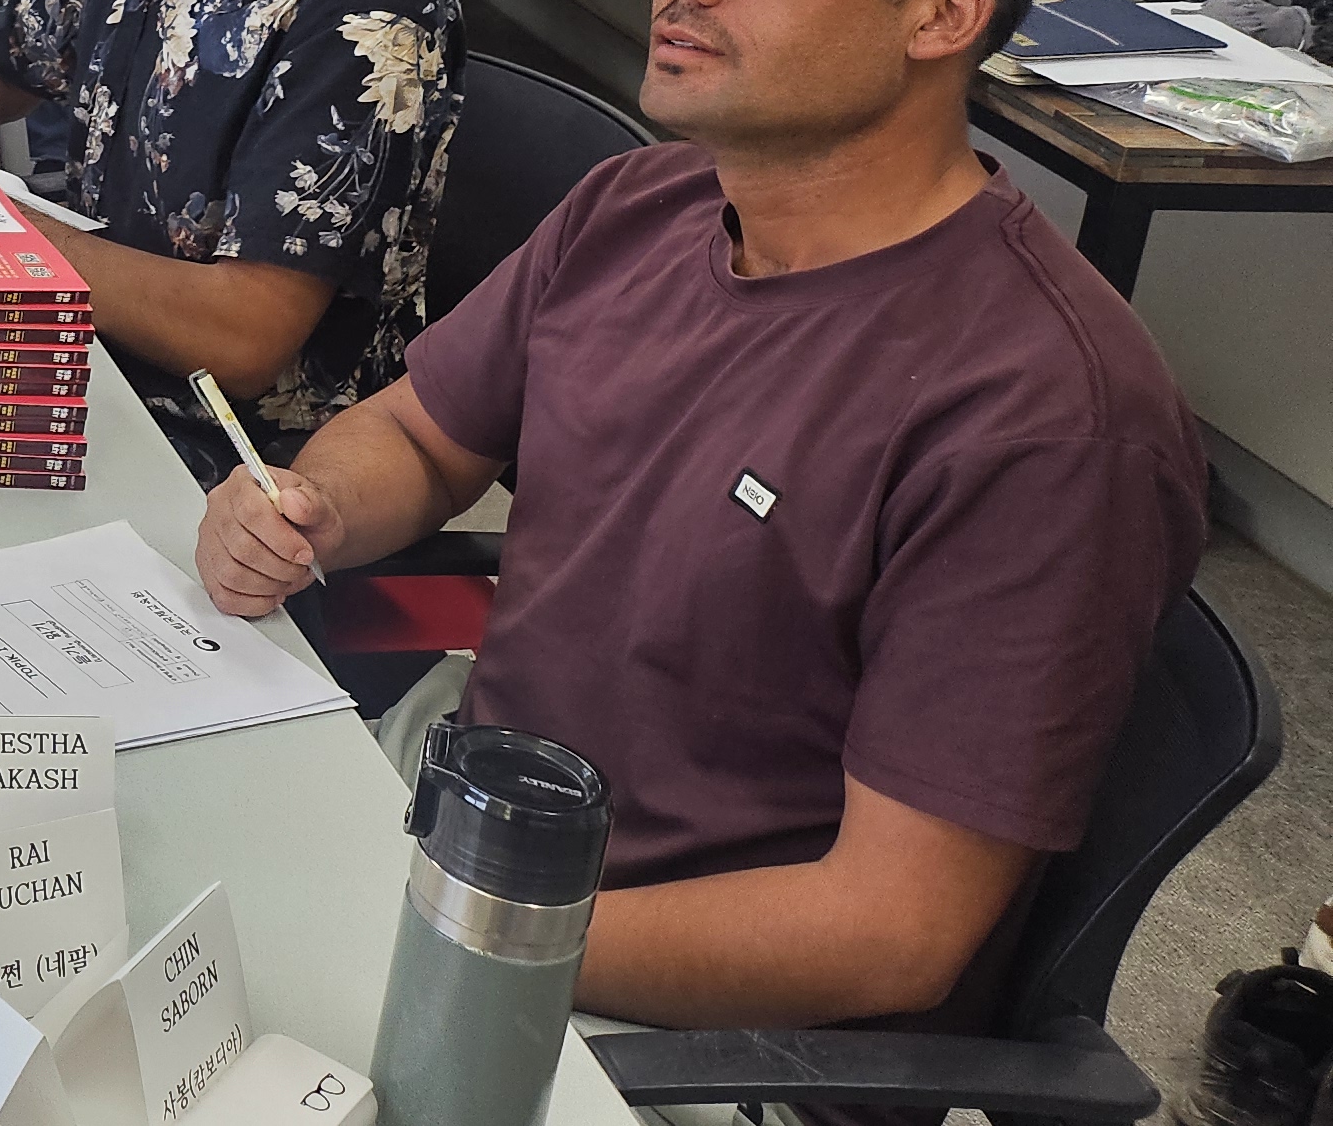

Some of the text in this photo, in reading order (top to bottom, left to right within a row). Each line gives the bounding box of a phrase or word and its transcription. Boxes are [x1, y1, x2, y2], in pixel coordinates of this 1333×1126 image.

[8, 653, 39, 679] TOPIK
[8, 839, 51, 870] RAI
[36, 942, 99, 984] (네팔)
[163, 931, 201, 983] CHIN
[160, 959, 220, 1033] SABORN
